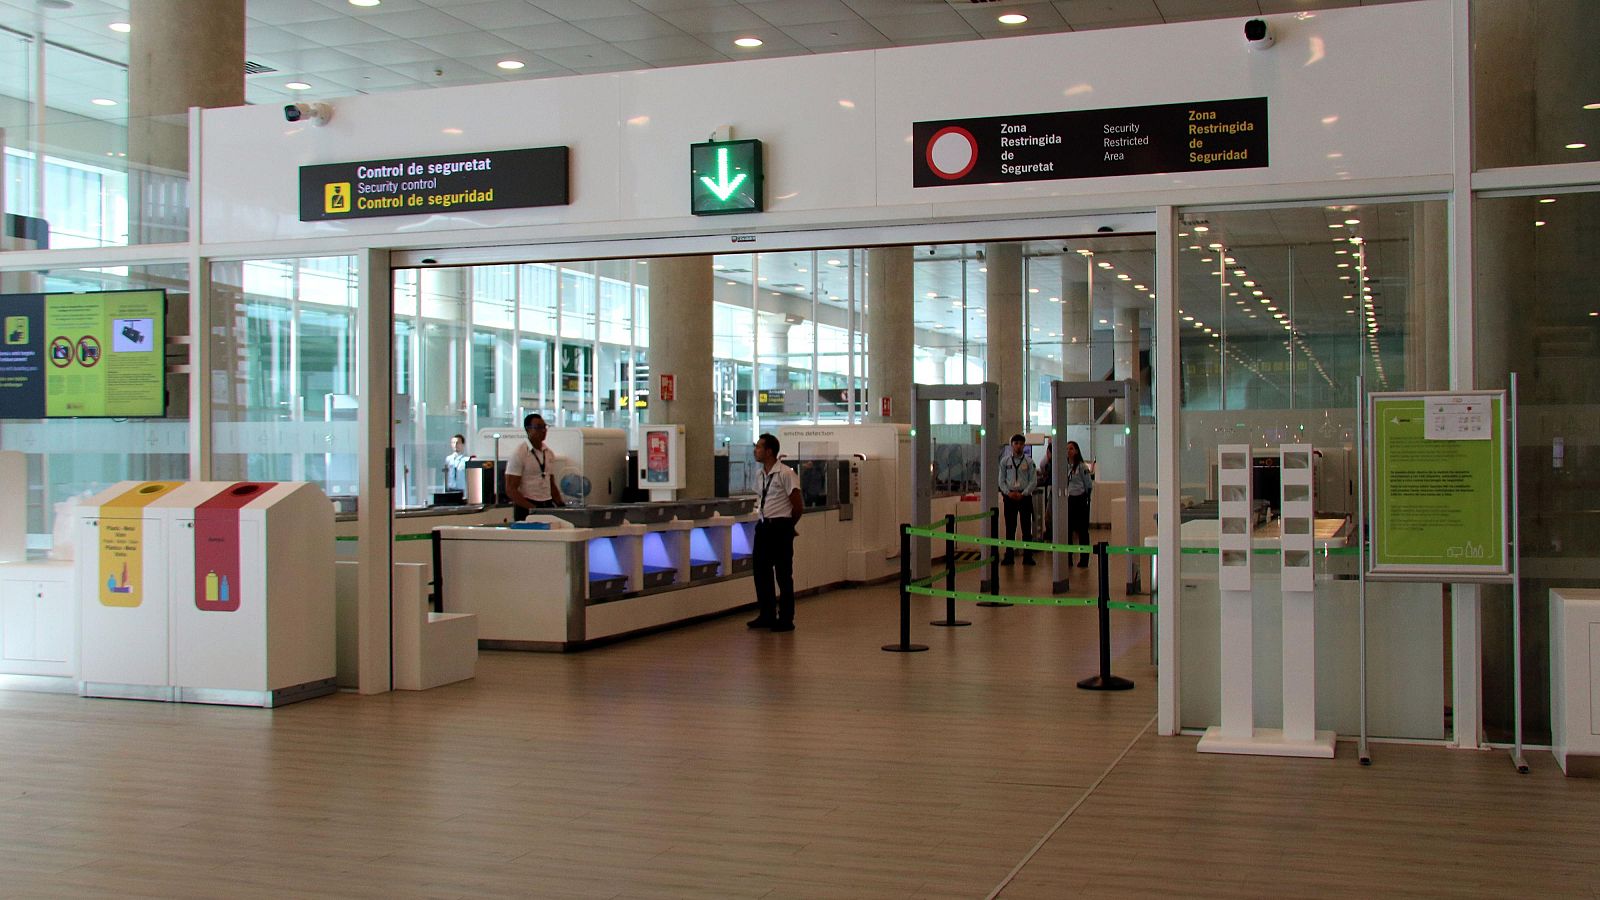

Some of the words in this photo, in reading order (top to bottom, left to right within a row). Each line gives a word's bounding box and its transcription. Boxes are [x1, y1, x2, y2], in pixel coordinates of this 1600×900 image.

[1188, 110, 1217, 121] Zona
[1000, 123, 1027, 134] Zona
[1103, 122, 1140, 135] Security
[1188, 121, 1255, 136] Restringida
[1000, 133, 1062, 148] Restringida
[1103, 135, 1149, 148] Restricted
[1189, 138, 1203, 149] de
[1001, 150, 1015, 161] de
[1103, 151, 1125, 162] Area
[1189, 149, 1248, 164] Seguridad
[357, 163, 403, 179] Control
[408, 161, 424, 176] de
[428, 158, 492, 176] seguretat
[1001, 161, 1055, 175] Seguretat
[358, 180, 398, 195] Security
[401, 177, 437, 191] control
[357, 194, 403, 210] Control
[408, 192, 424, 207] de
[428, 189, 494, 208] seguridad
